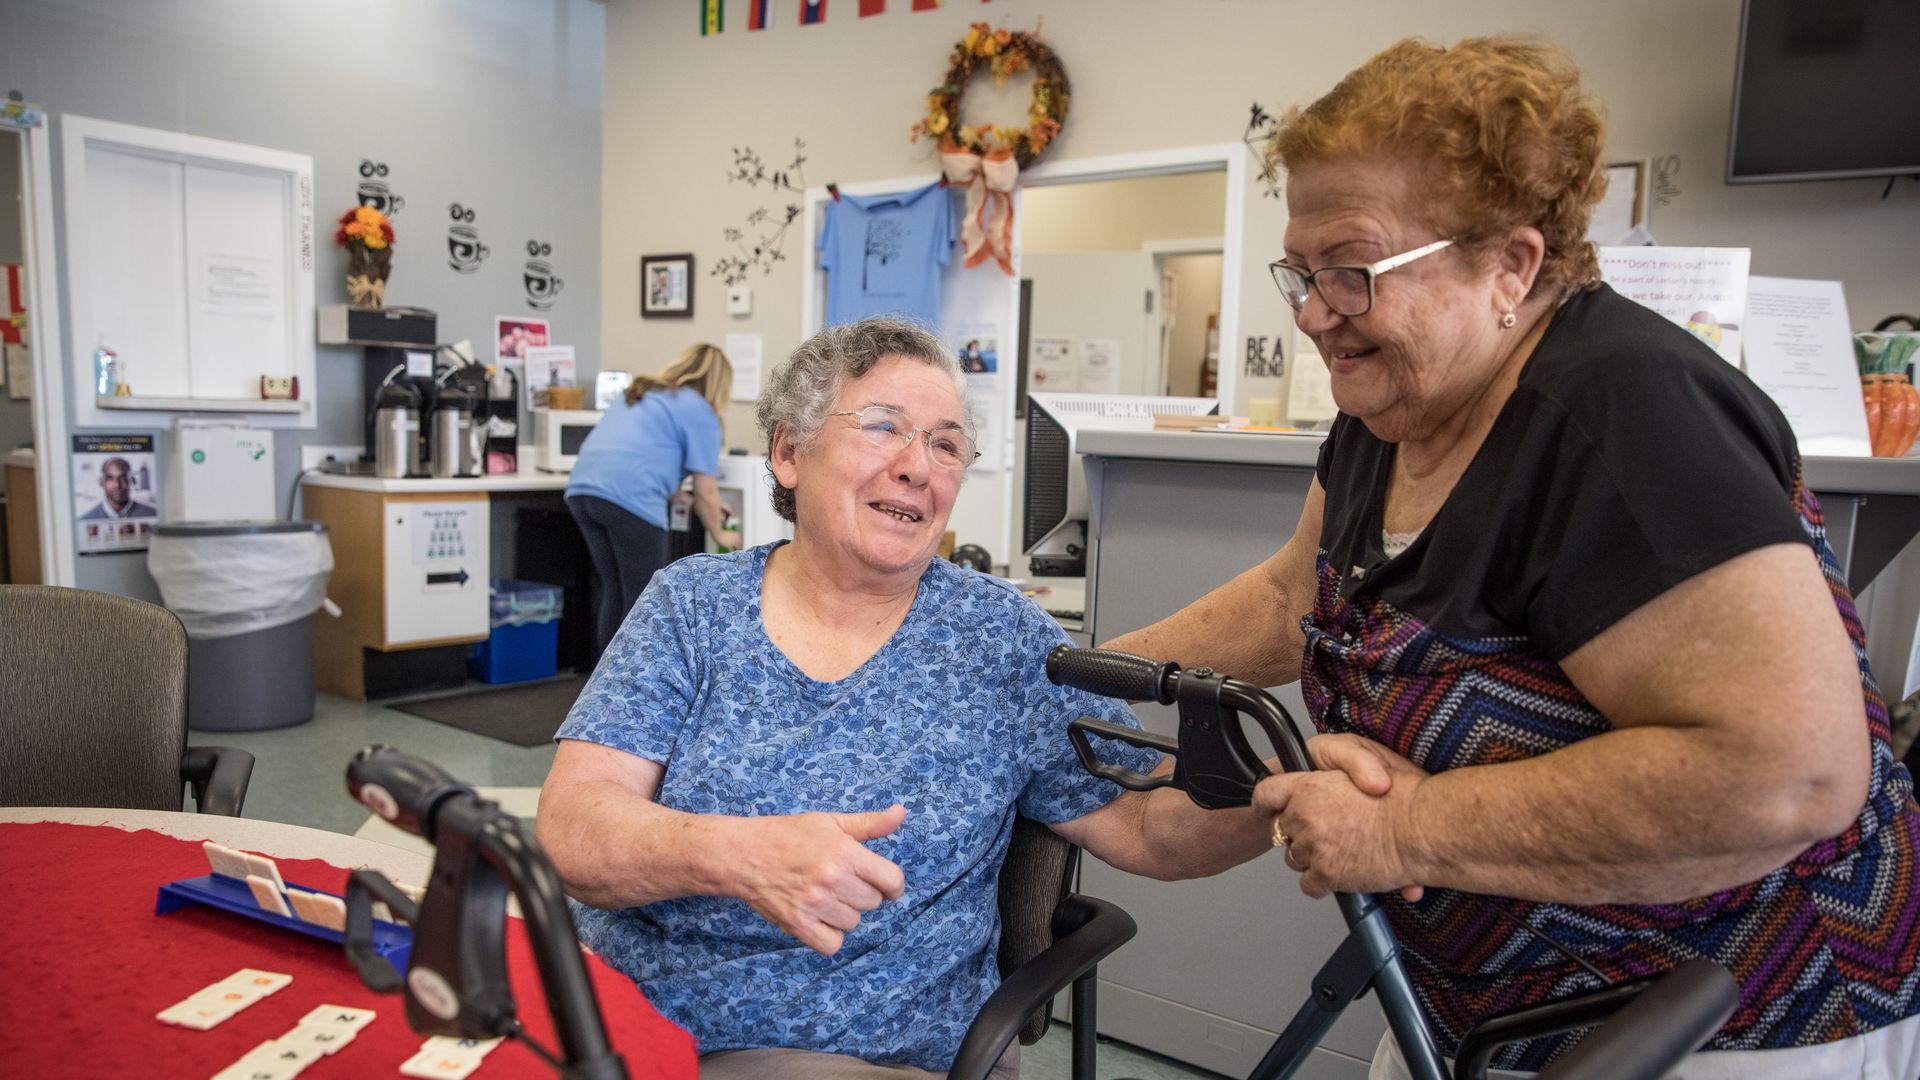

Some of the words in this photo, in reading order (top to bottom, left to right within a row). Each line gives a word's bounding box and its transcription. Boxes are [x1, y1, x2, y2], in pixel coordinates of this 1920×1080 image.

[1658, 260, 1682, 270] miss
[1628, 276, 1645, 284] part
[1646, 275, 1655, 283] of
[1632, 293, 1647, 301] we
[1649, 291, 1672, 301] take
[1674, 293, 1693, 301] our
[1246, 337, 1267, 361] BE
[1272, 336, 1284, 361] A
[1244, 361, 1284, 377] FRIEND
[335, 1014, 356, 1022] 2
[313, 1032, 335, 1042] 3
